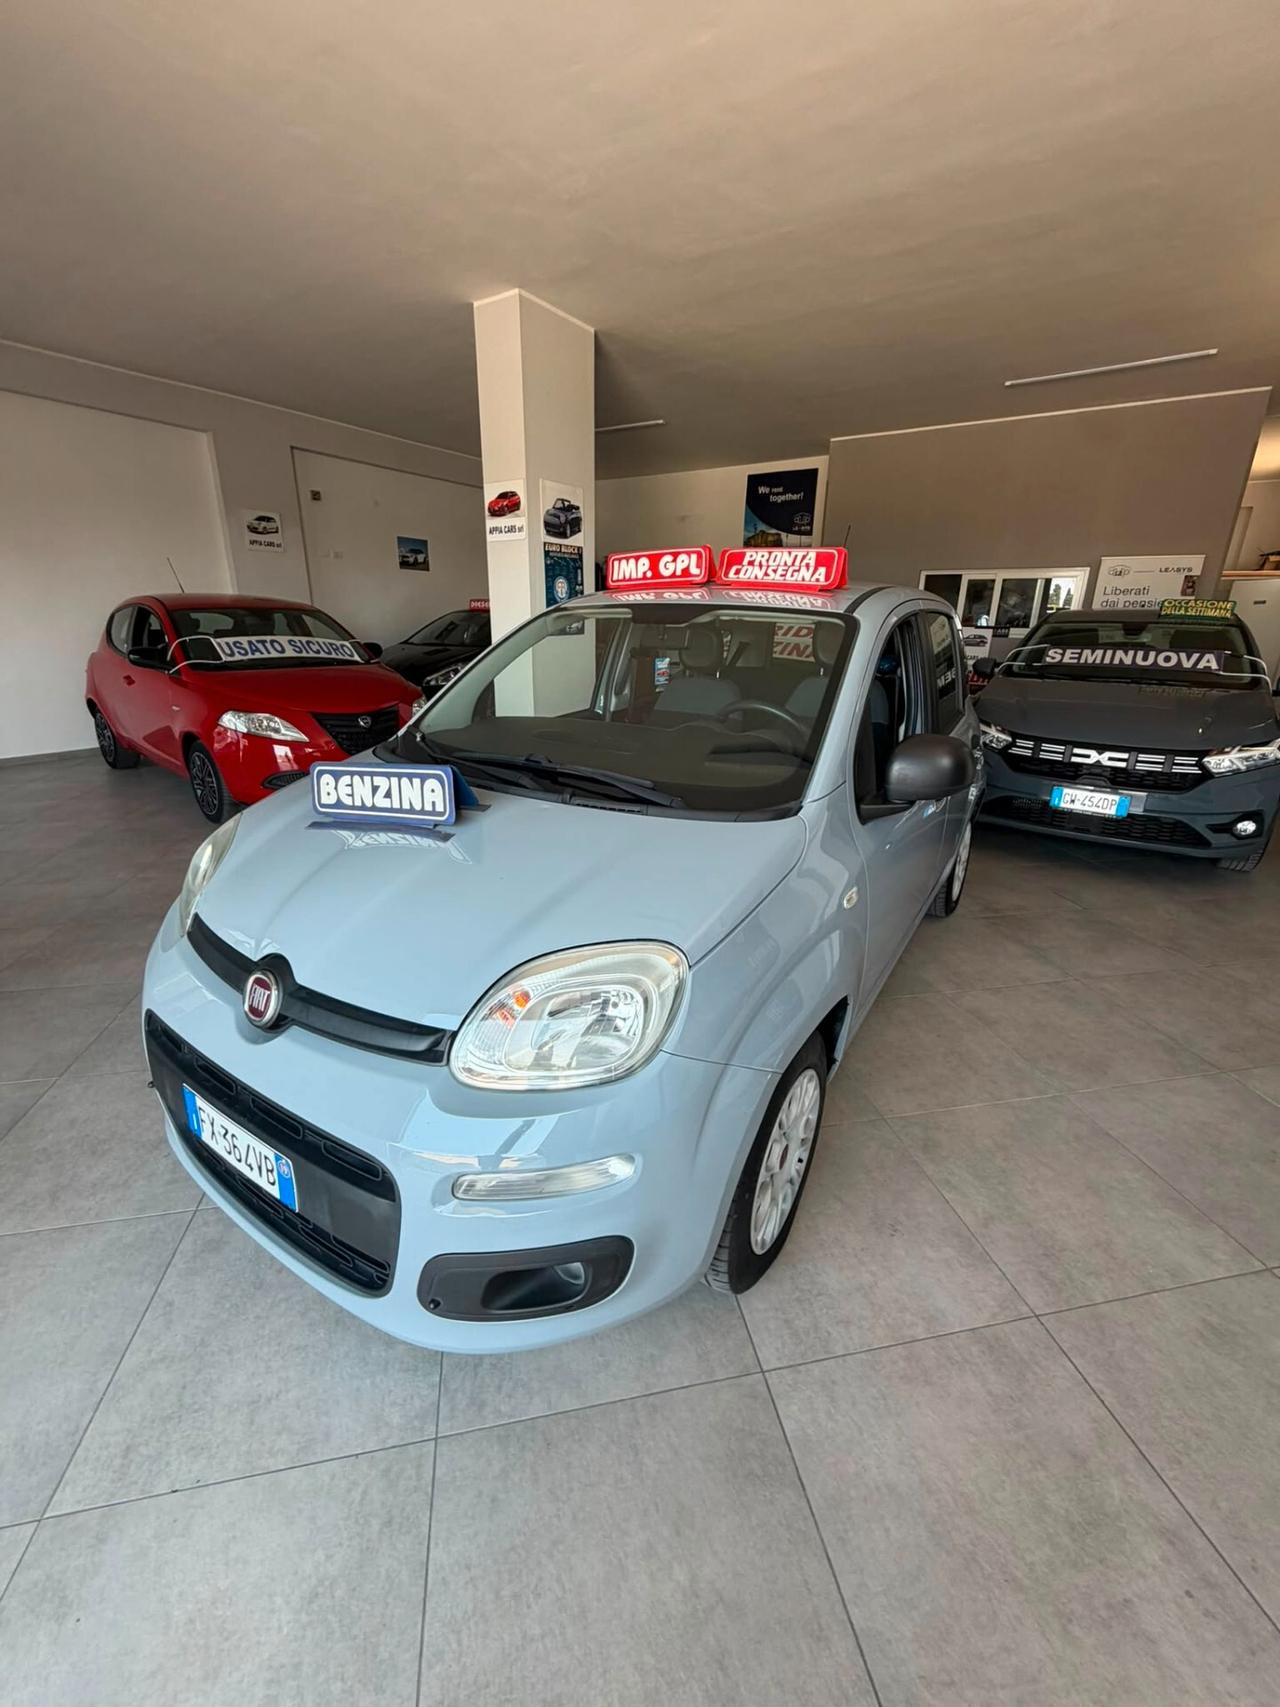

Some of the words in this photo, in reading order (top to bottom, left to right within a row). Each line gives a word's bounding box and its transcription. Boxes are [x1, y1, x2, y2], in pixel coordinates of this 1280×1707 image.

[758, 486, 770, 494] We
[489, 525, 503, 535] APPIA
[504, 525, 517, 534] CARS
[545, 543, 560, 552] EURO
[742, 551, 816, 567] PRONTA
[612, 557, 652, 581] IMP.
[658, 553, 701, 578] GPL
[728, 565, 826, 582] CONSEGNA
[1103, 586, 1150, 596] Liberati
[1100, 598, 1120, 608] dai
[1164, 600, 1234, 610] OCCASIONE
[1161, 606, 1185, 615] DELLA
[1187, 607, 1231, 618] SETTIMANA
[218, 639, 286, 658] USATO
[288, 639, 355, 658] SICURO
[1046, 648, 1220, 670] SEMINUOVA
[320, 773, 444, 812] BENZINA
[249, 983, 270, 1012] FIAT
